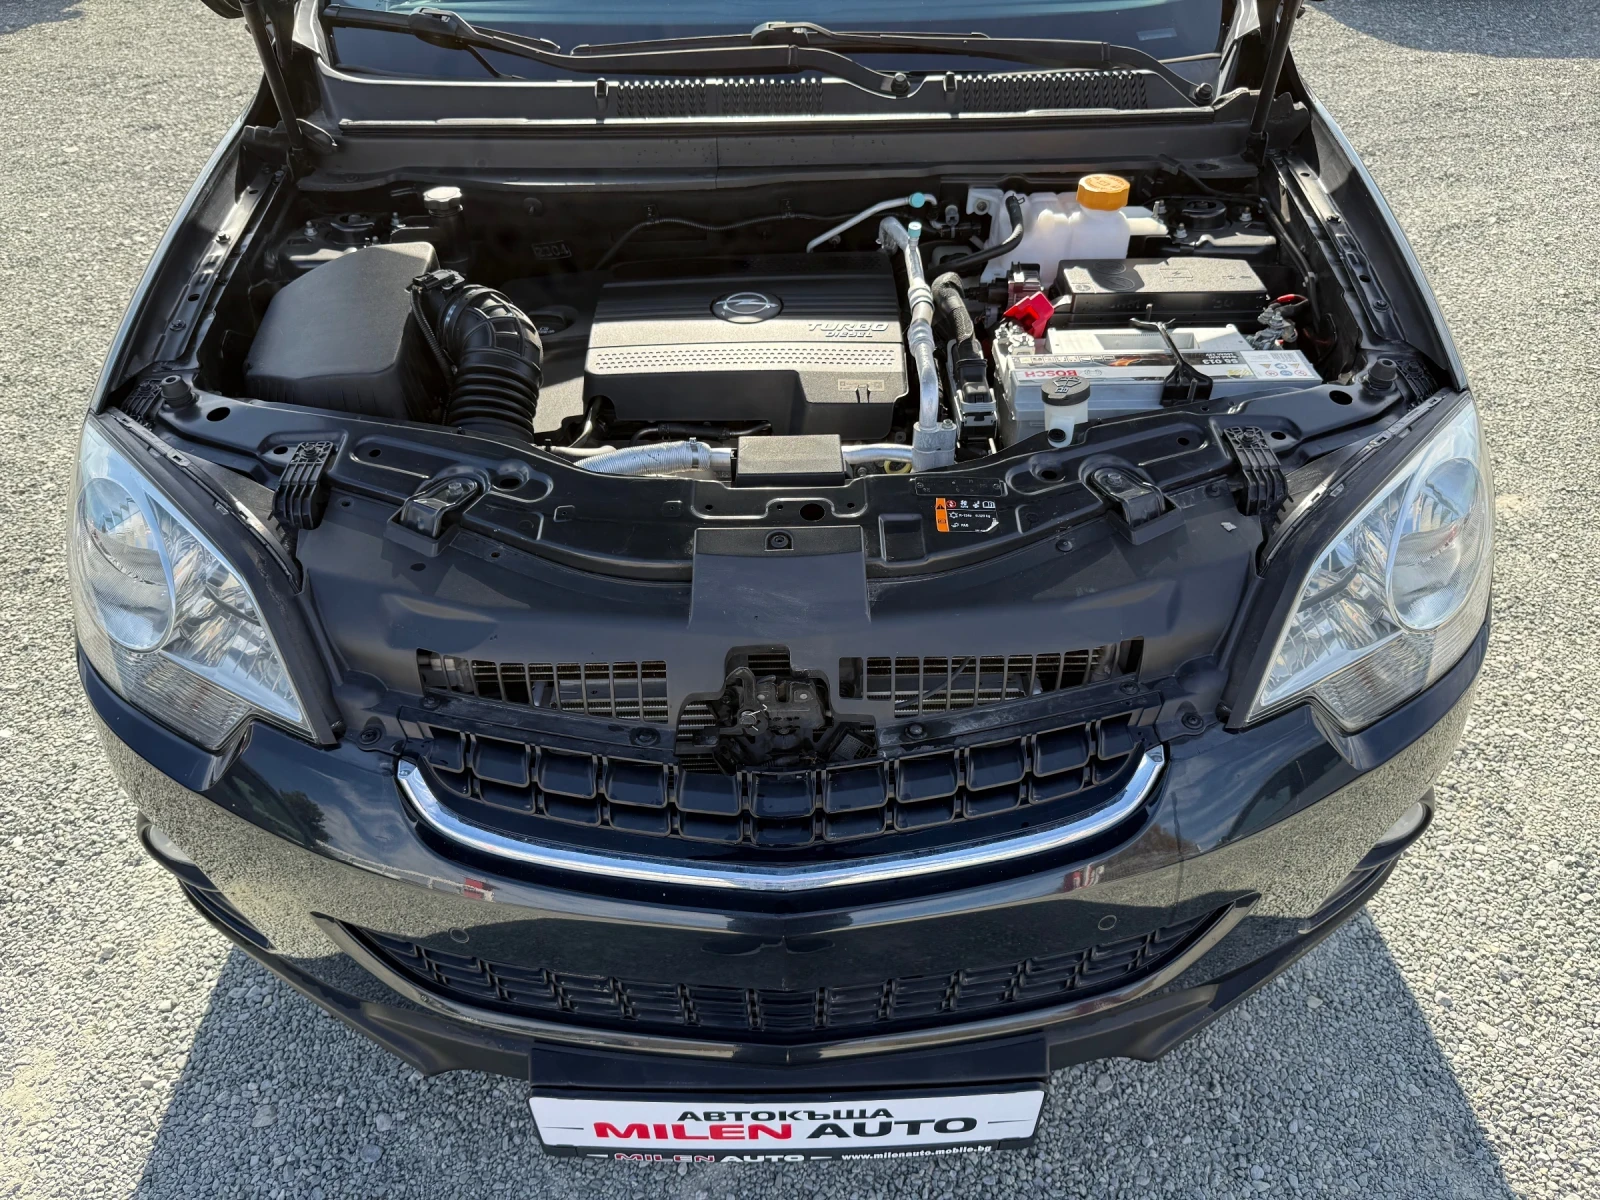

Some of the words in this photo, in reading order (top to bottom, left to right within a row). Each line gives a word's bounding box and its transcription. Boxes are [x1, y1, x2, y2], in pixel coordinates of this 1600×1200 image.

[808, 322, 889, 331] TURBO
[1024, 370, 1078, 378] BOSCH
[593, 1122, 792, 1140] MILEN
[806, 1117, 978, 1139] AUTO
[614, 1153, 715, 1163] MILEN
[720, 1154, 805, 1163] AUTO
[841, 1145, 992, 1160] www.milenauto.mobile.bg
